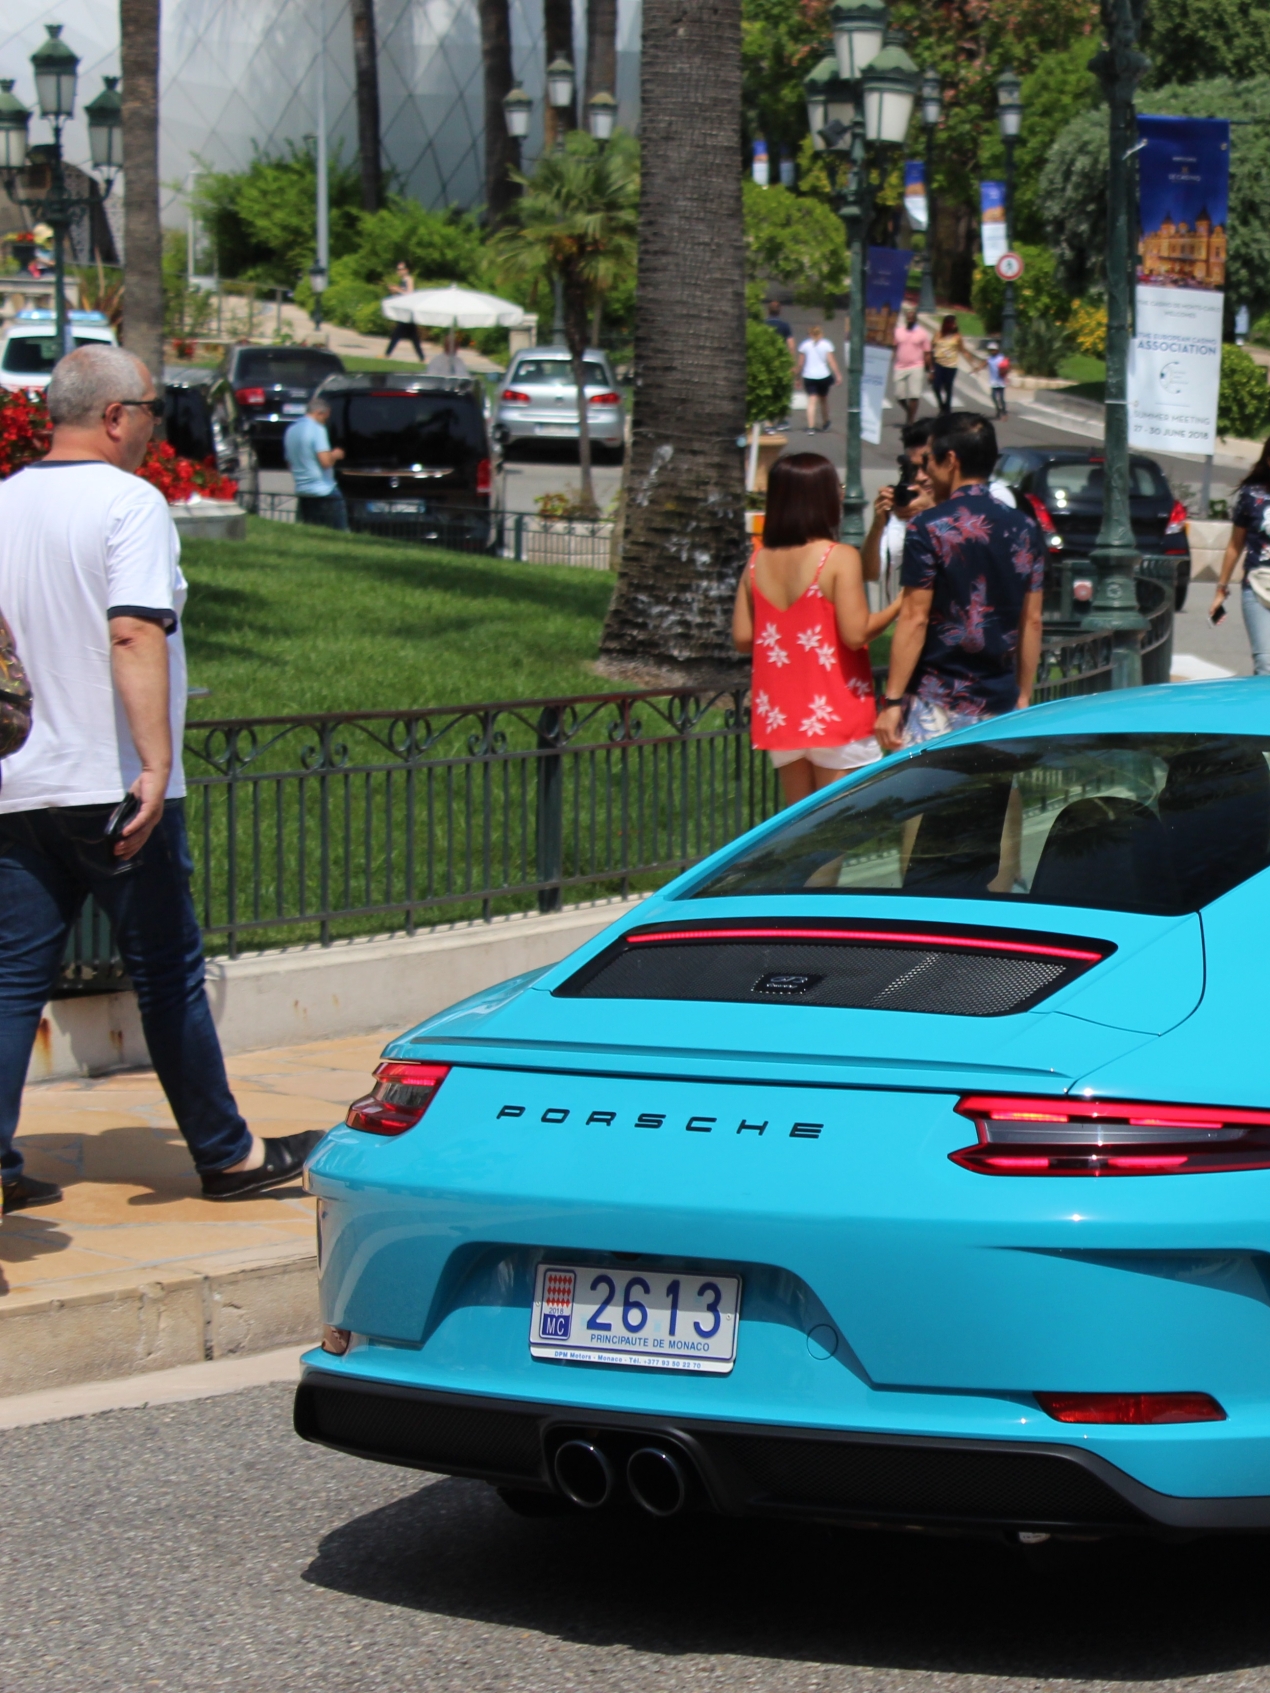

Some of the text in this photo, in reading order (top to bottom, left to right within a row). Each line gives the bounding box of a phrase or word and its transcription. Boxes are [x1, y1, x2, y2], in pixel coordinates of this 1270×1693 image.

[1137, 340, 1216, 356] ASSOCIATION
[1153, 333, 1192, 342] EUROPEAN
[1192, 336, 1217, 345] CASINO
[1133, 409, 1211, 426] SUMMER MEETING
[1133, 424, 1143, 433] 27
[1148, 426, 1161, 435] 30
[1162, 428, 1186, 438] JUNE
[1187, 430, 1210, 440] 2018
[496, 1104, 824, 1139] PORSCHE
[548, 1306, 565, 1315] 2018
[586, 1274, 722, 1339] 2613
[545, 1317, 565, 1336] MC
[590, 1333, 710, 1352] PRINCIPAUTE DE MONACO
[554, 1350, 568, 1358] DPM
[569, 1351, 592, 1360] Motors
[597, 1354, 623, 1363] Monaco
[644, 1358, 660, 1366] +377
[682, 1361, 691, 1369] 22
[692, 1362, 702, 1370] 70
